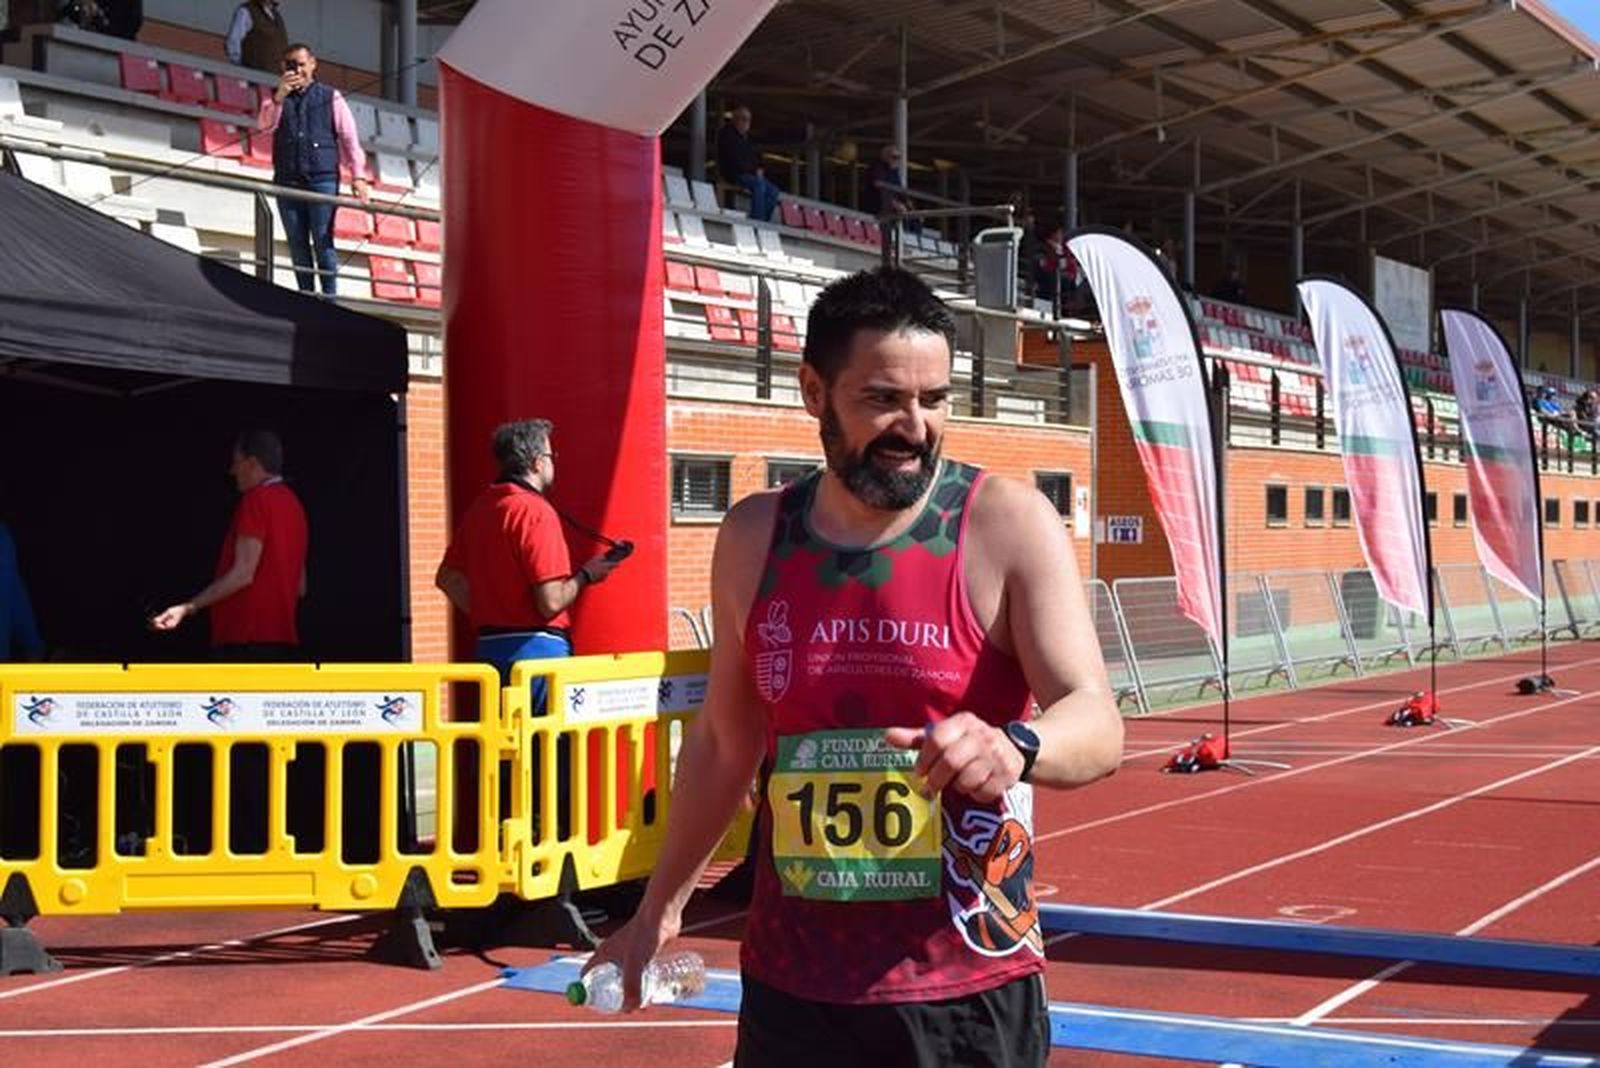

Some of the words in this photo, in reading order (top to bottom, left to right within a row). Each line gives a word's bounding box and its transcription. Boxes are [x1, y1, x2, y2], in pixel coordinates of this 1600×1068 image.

[634, 23, 685, 70] DE
[810, 619, 870, 643] APIS
[877, 619, 950, 649] DURI
[911, 668, 961, 682] ZAMORA
[95, 709, 140, 718] CASTILLA
[281, 709, 324, 717] CASTILLA
[821, 738, 896, 752] FUNDAC
[821, 754, 859, 769] CAJA
[787, 782, 912, 847] 156
[817, 871, 859, 887] CAJA
[864, 872, 931, 887] RURAL
